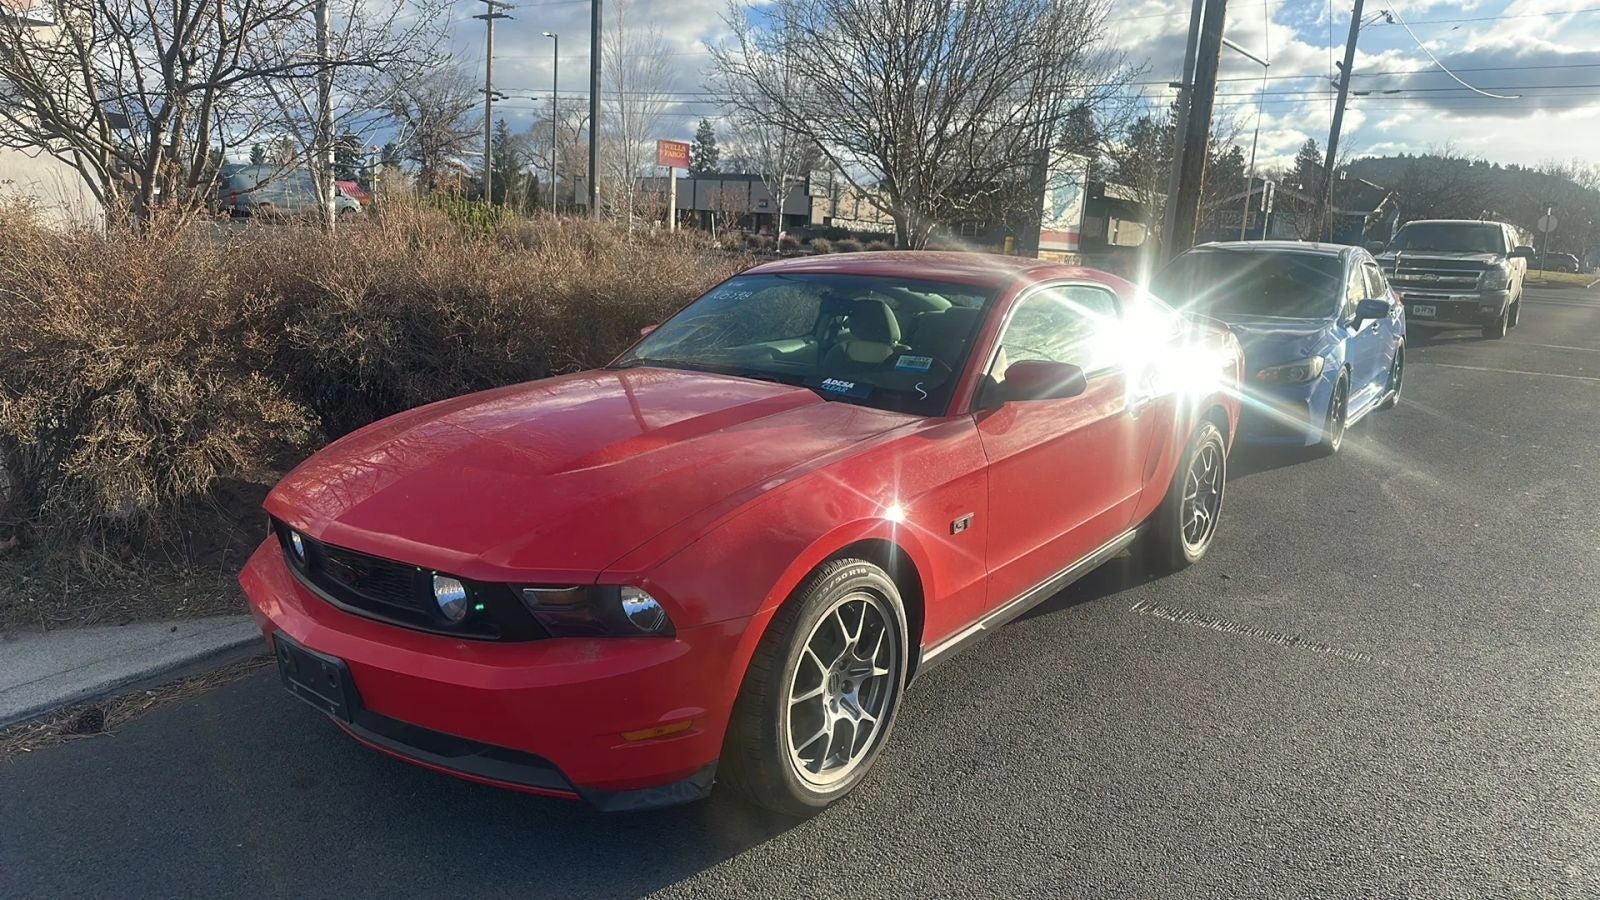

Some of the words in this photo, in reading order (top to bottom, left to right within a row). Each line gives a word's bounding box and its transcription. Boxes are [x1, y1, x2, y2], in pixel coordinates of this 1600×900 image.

[664, 143, 686, 152] WELLS
[664, 151, 686, 159] FARGO
[821, 384, 849, 393] CLEAR
